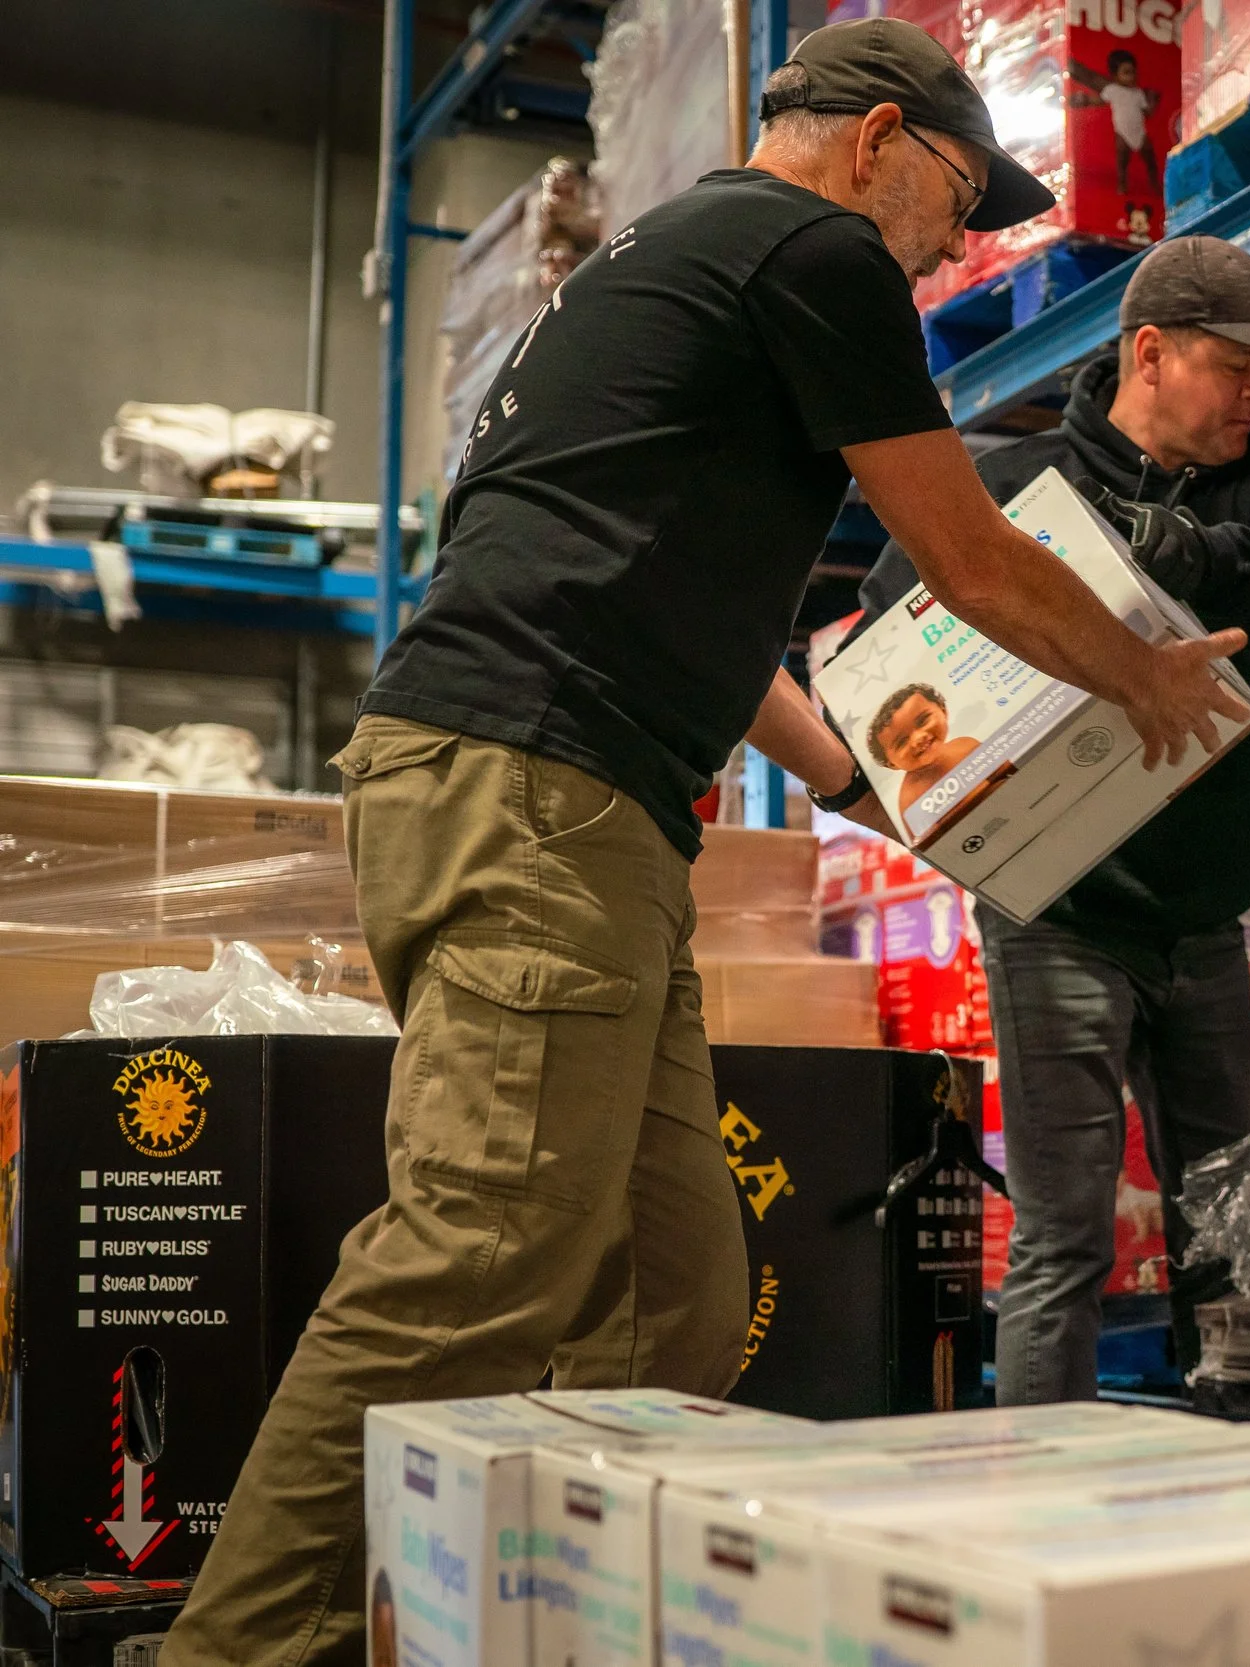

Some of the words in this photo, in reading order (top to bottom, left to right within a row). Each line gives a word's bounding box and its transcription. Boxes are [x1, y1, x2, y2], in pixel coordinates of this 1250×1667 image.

[1068, 0, 1182, 46] HUG
[920, 777, 960, 814] 900
[112, 1050, 211, 1096] DULCINEA
[117, 1112, 130, 1135] FRUIT
[127, 1135, 137, 1145] OF
[136, 1143, 177, 1158] LEGENDARY
[178, 1111, 207, 1153] PERFECTION
[103, 1171, 149, 1187] PURE
[164, 1170, 222, 1186] HEART
[103, 1206, 174, 1222] TUSCAN
[187, 1205, 242, 1221] STYLE
[102, 1241, 146, 1256] RUBY
[160, 1240, 208, 1256] BLISS
[101, 1274, 147, 1292] SUGAR
[149, 1274, 194, 1292] DADDY
[101, 1309, 161, 1325] SUNNY
[176, 1309, 226, 1325] GOLD
[177, 1502, 227, 1516] WATC
[189, 1520, 218, 1534] STE
